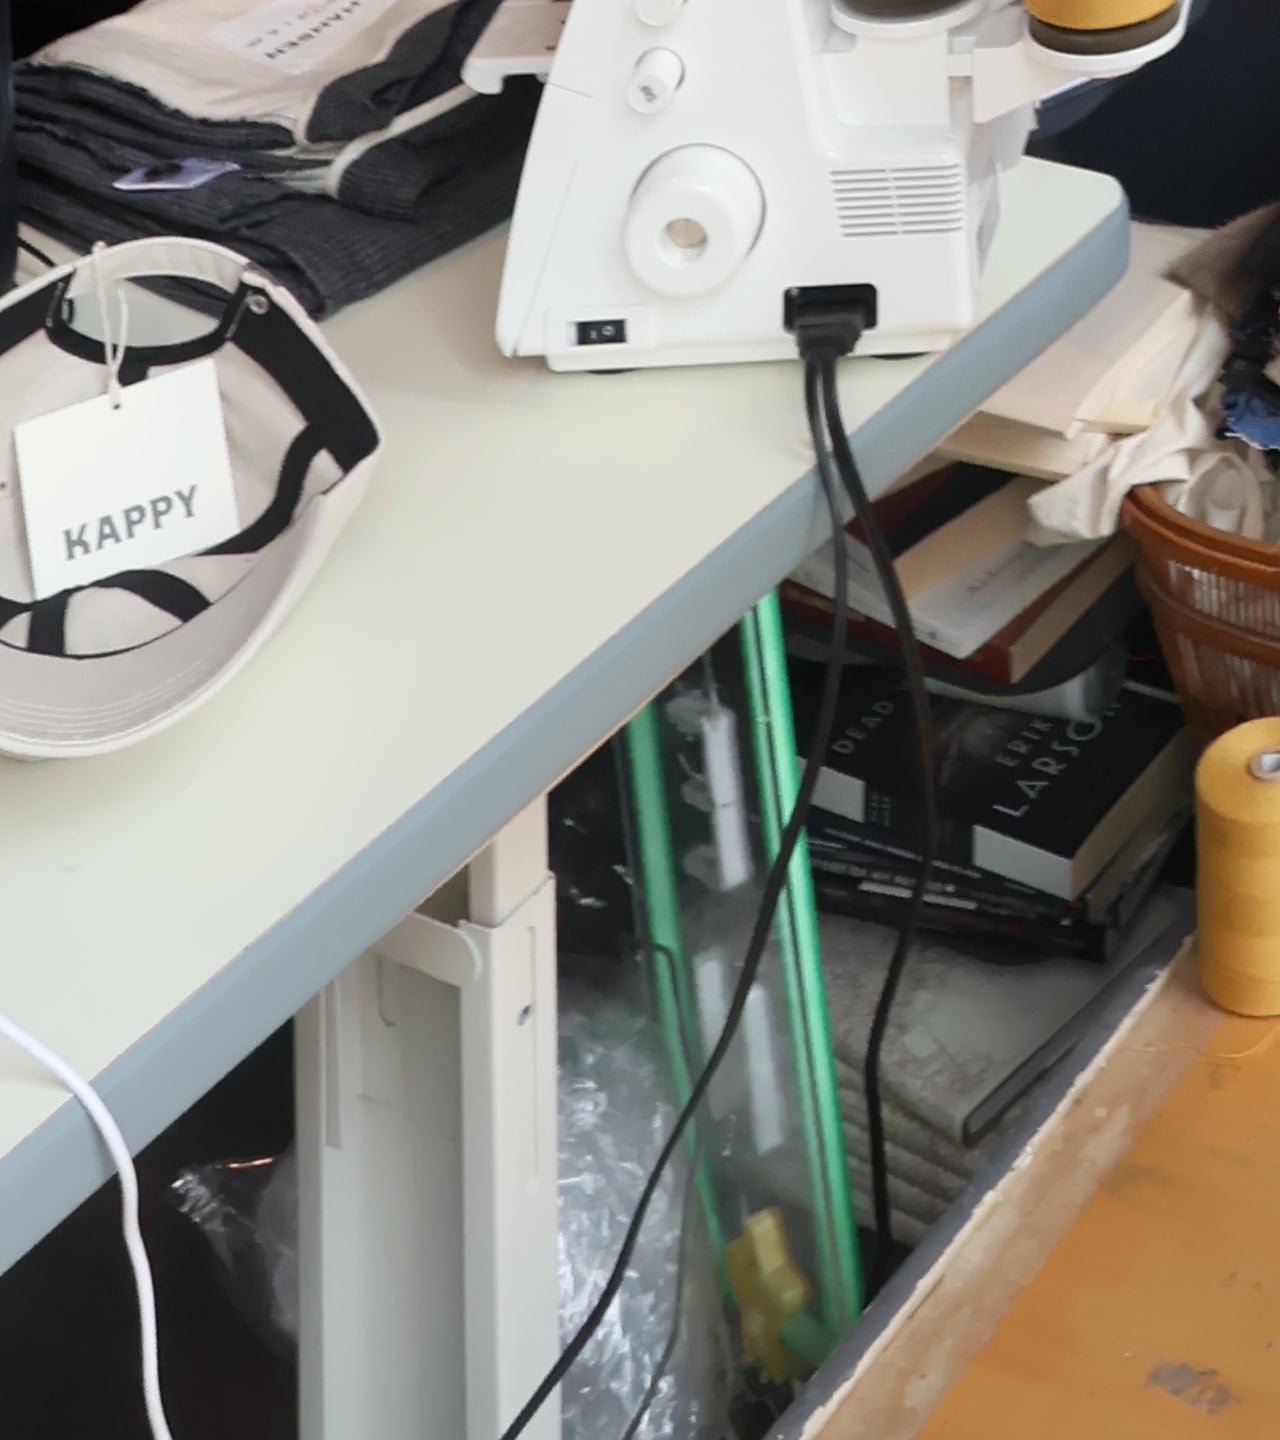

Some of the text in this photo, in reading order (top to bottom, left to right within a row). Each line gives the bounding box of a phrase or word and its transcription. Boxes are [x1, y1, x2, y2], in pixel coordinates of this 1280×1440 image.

[62, 483, 198, 562] KAPPY
[831, 701, 894, 755] DEAD
[992, 701, 1120, 818] LARSO
[993, 720, 1055, 768] ERIK
